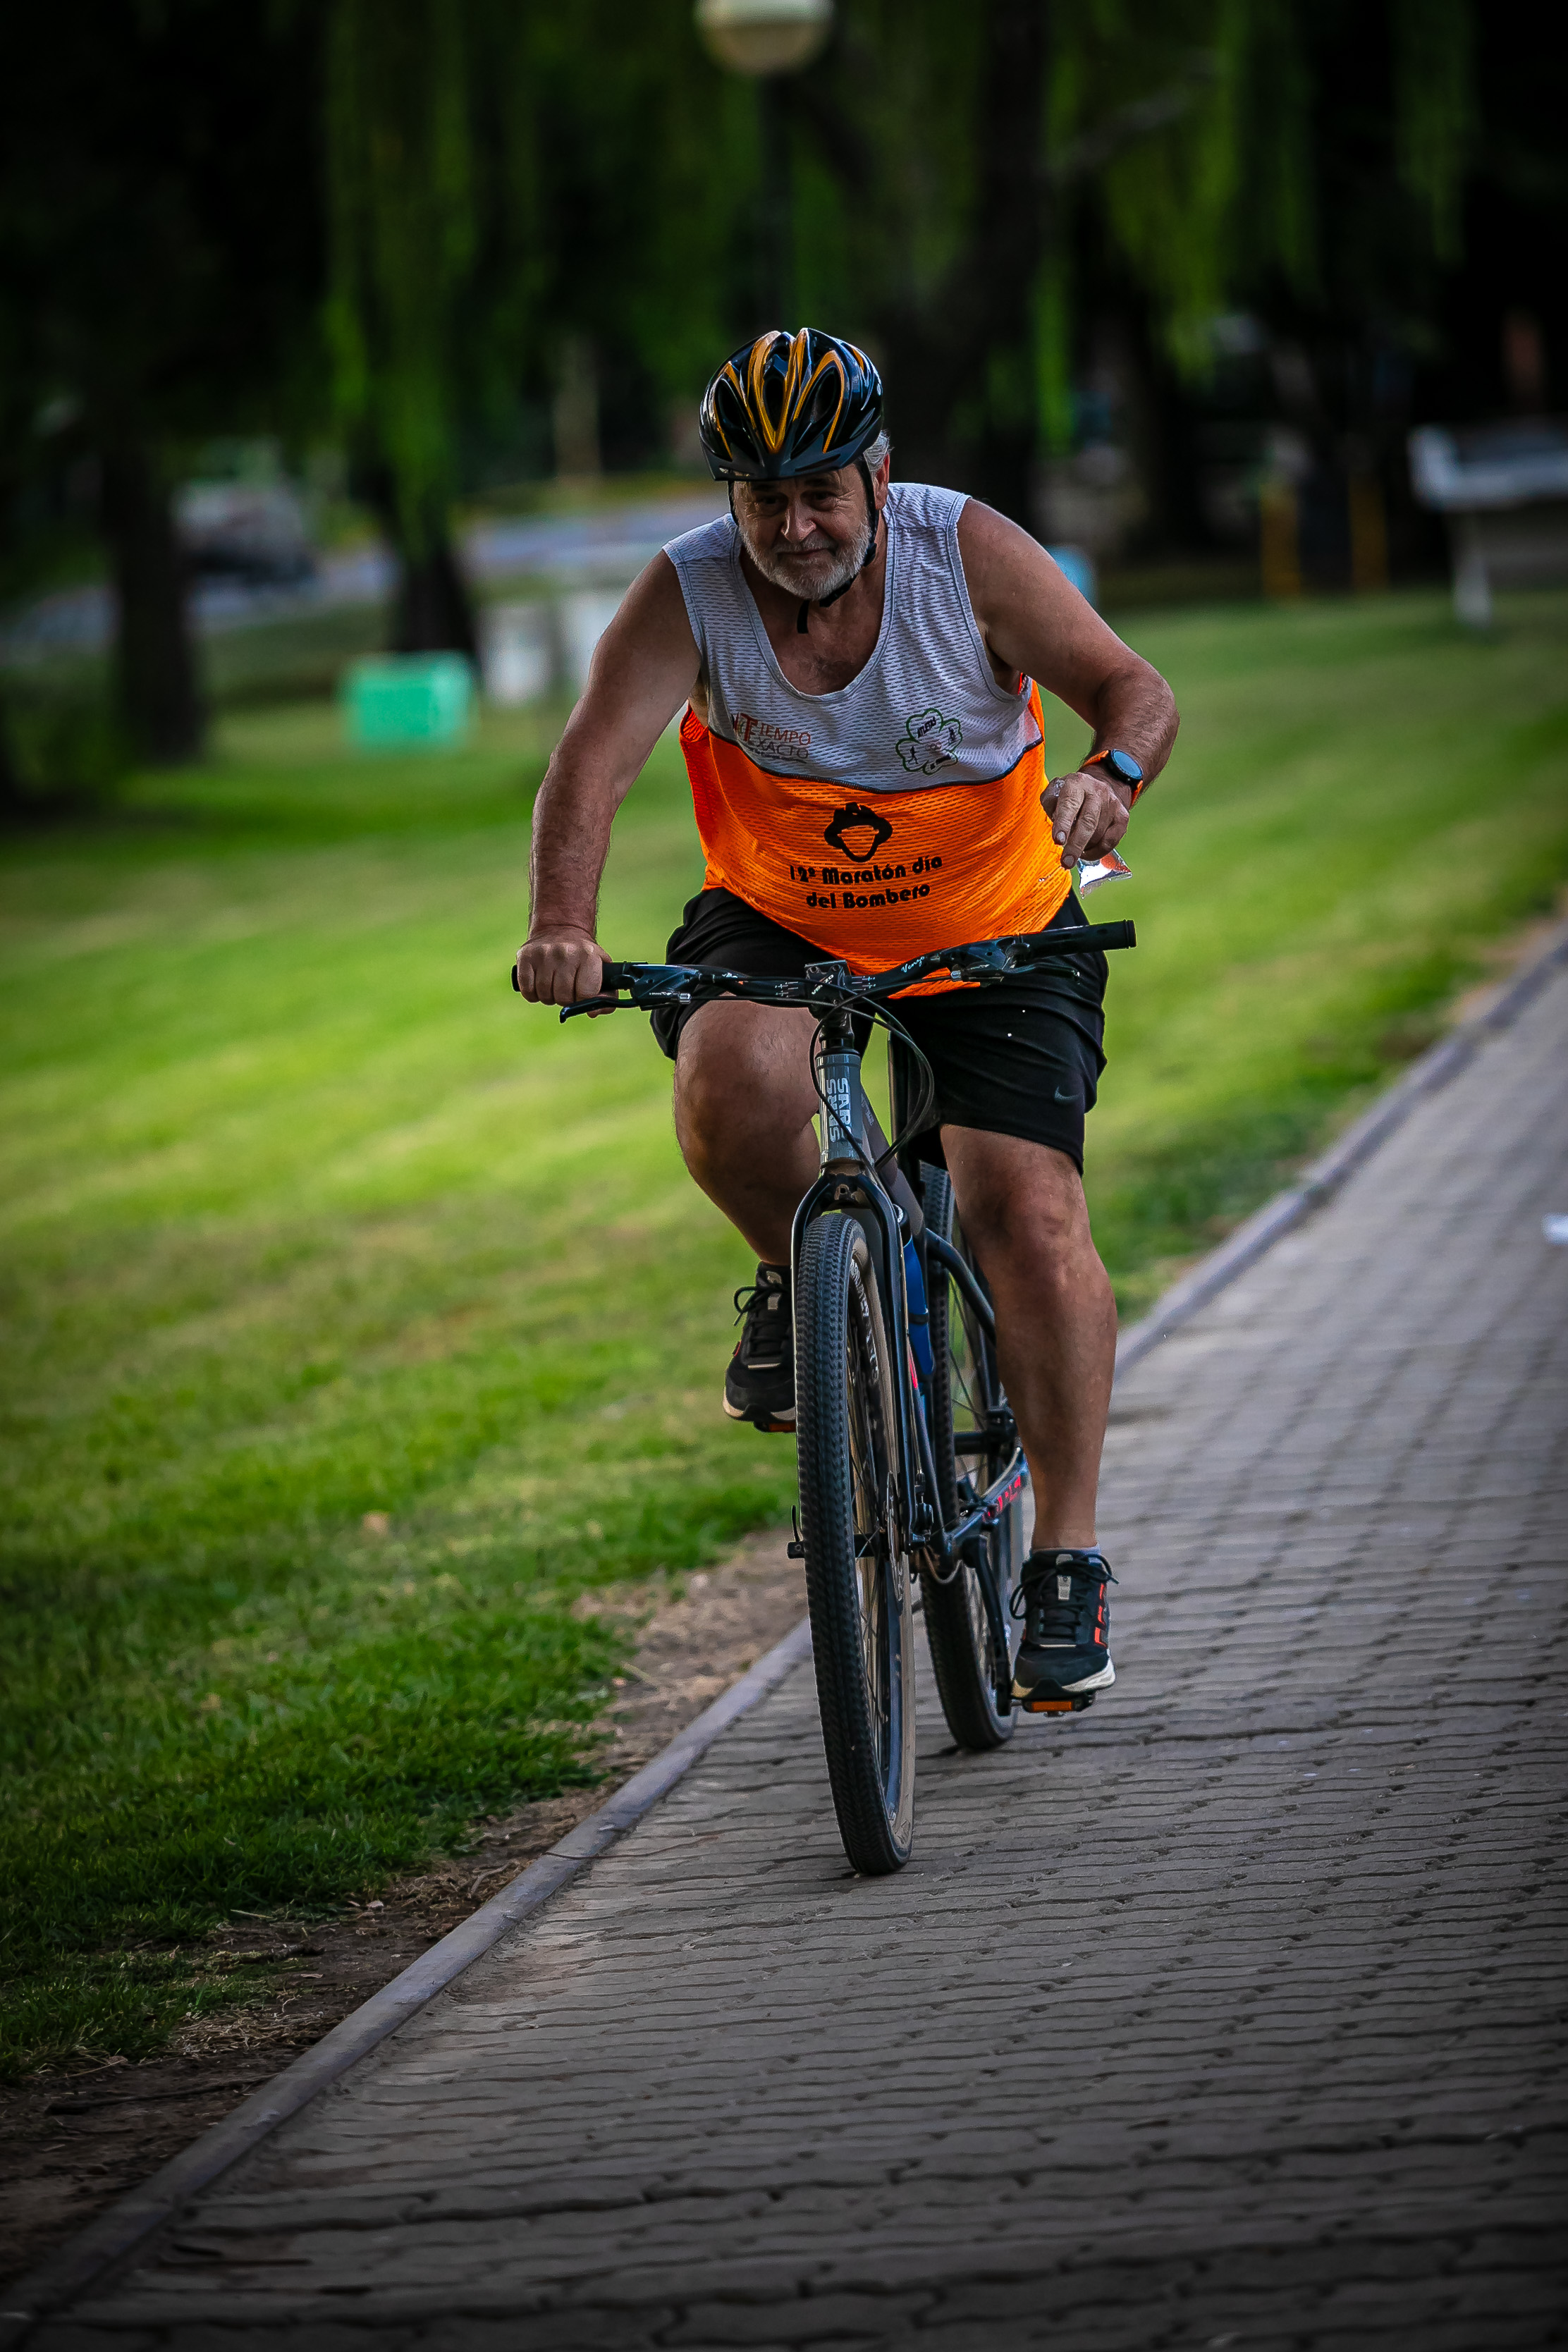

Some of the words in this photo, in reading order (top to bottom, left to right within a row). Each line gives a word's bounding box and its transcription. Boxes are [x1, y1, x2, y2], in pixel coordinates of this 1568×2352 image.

[821, 863, 907, 885] Maratón
[912, 855, 943, 874] día
[806, 891, 837, 909] del
[842, 883, 931, 909] Bombero
